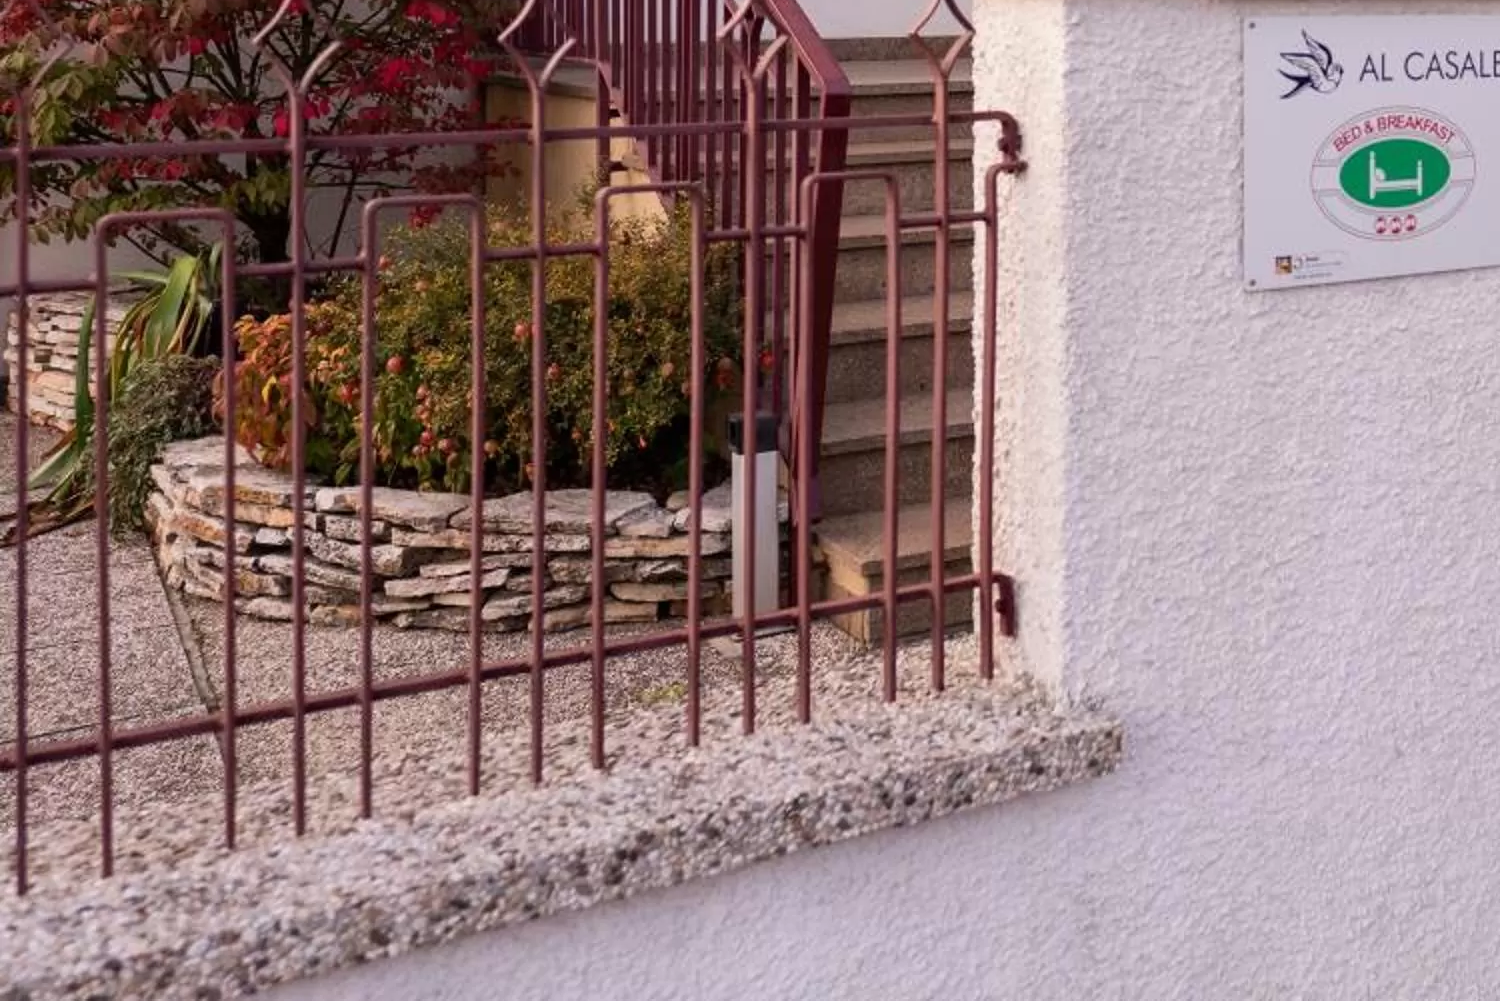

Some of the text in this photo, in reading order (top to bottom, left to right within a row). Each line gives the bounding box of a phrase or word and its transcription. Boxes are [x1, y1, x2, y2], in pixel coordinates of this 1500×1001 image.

[1359, 53, 1393, 81] AL
[1333, 114, 1455, 152] BED & BREAKFAST
